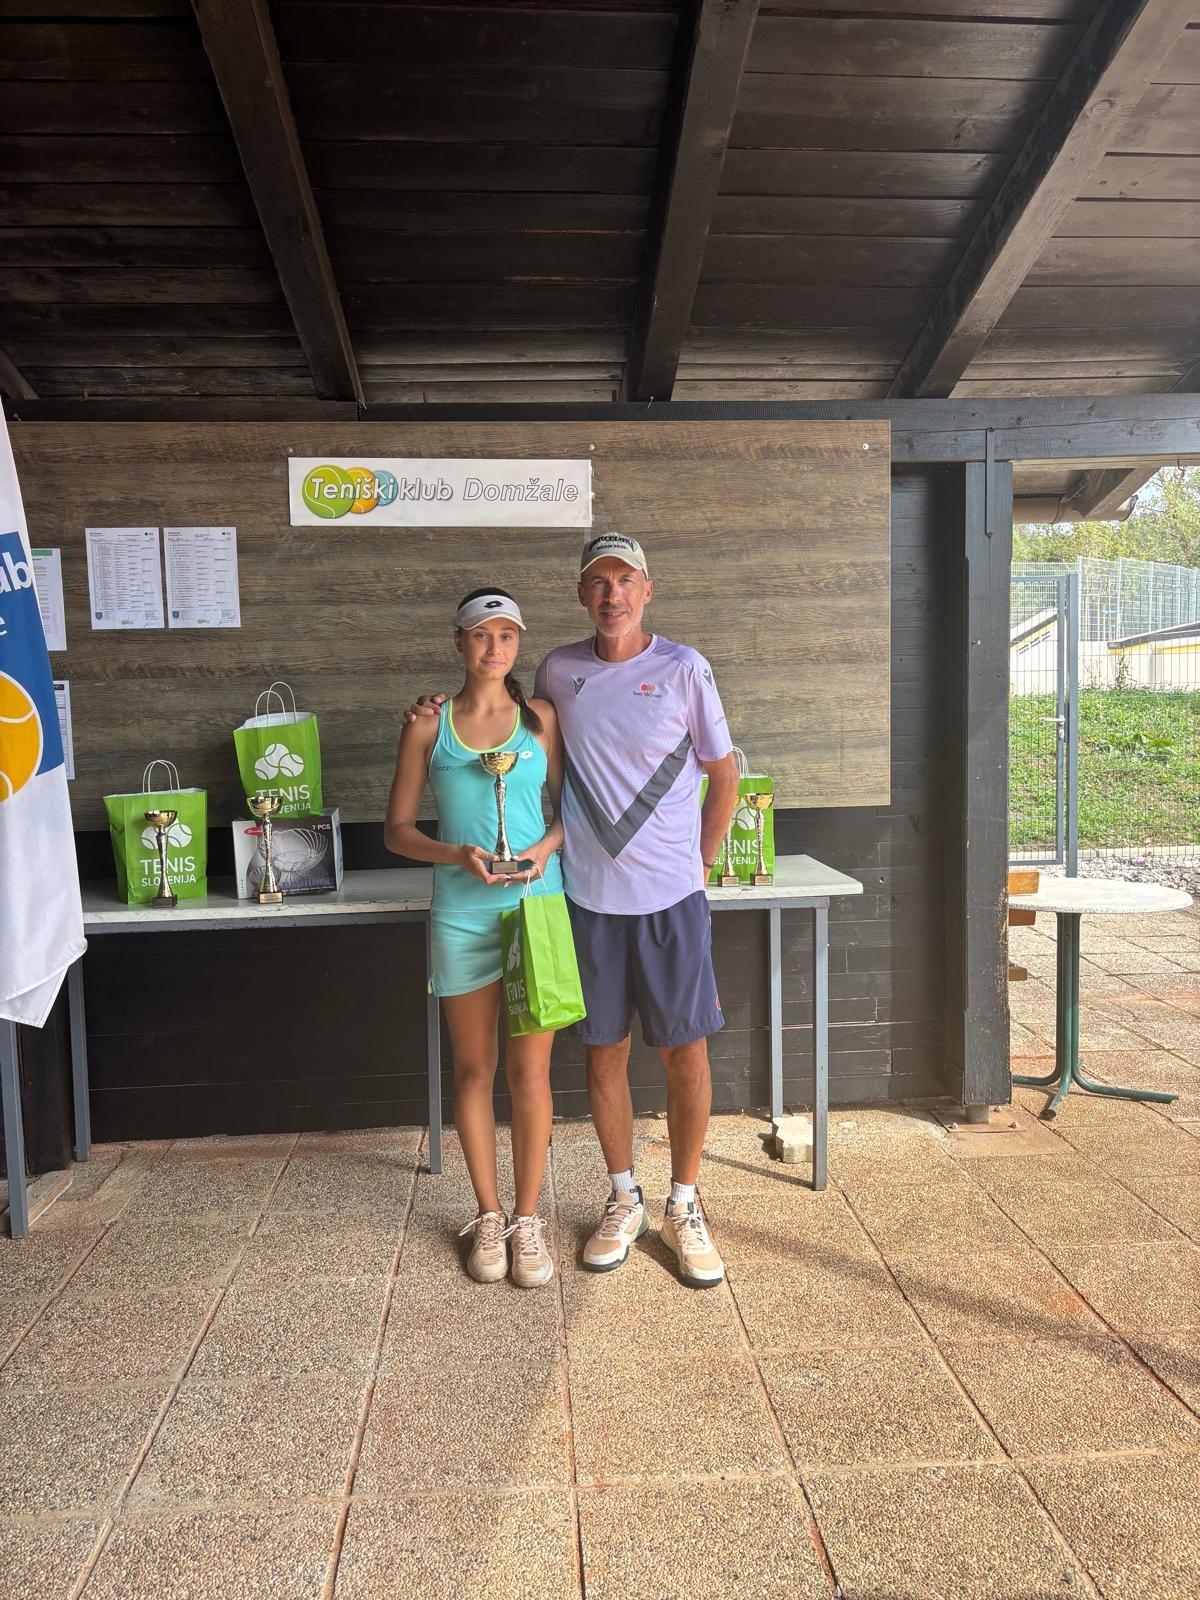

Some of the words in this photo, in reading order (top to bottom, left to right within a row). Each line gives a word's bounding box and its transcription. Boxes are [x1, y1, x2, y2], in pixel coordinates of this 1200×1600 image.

[311, 476, 395, 501] Teniški
[399, 477, 454, 502] klub
[463, 477, 579, 502] Domžale
[256, 784, 311, 802] TENIS
[317, 823, 331, 831] PCS
[722, 839, 760, 855] ENIS
[139, 855, 197, 876] TENIS
[713, 856, 757, 866] SLVENIJ
[141, 873, 197, 887] SLOENIJA
